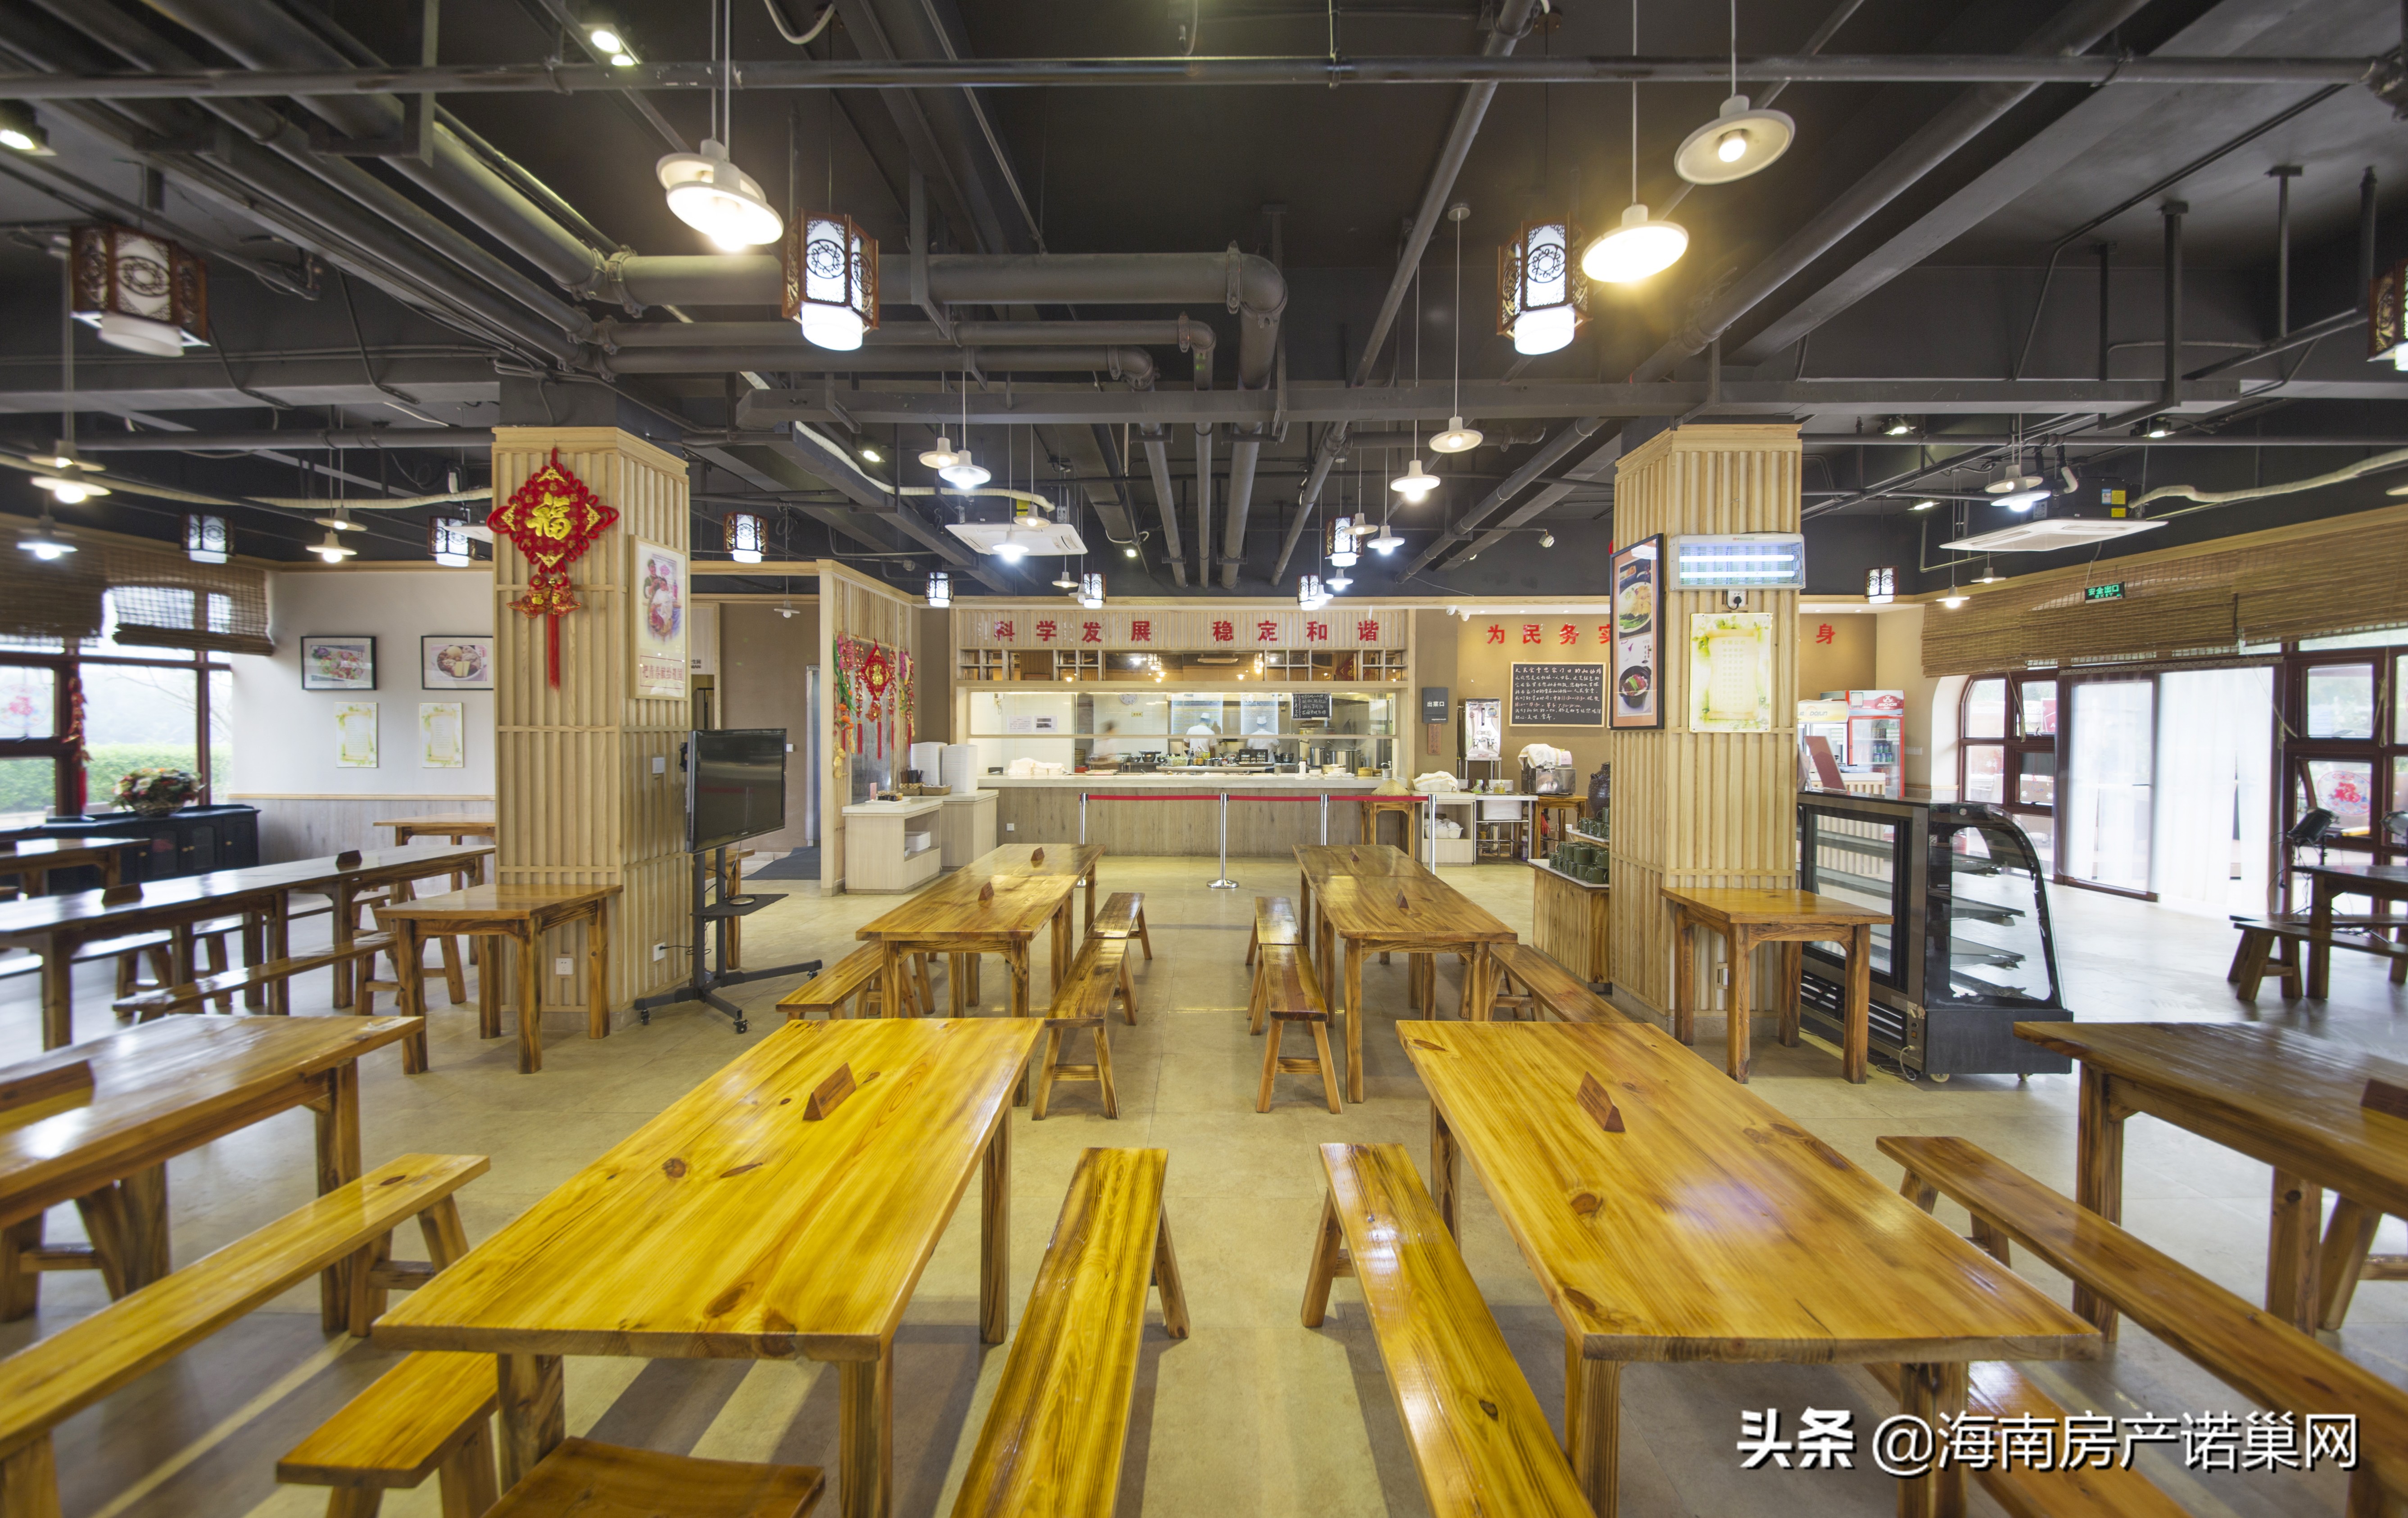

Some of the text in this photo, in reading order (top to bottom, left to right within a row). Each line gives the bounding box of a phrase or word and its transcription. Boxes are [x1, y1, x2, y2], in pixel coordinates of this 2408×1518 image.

[526, 492, 571, 540] 福
[2088, 584, 2119, 596] 安全出口
[994, 620, 1379, 642] 科学发展 稳定和谐
[1816, 623, 1836, 644] 身
